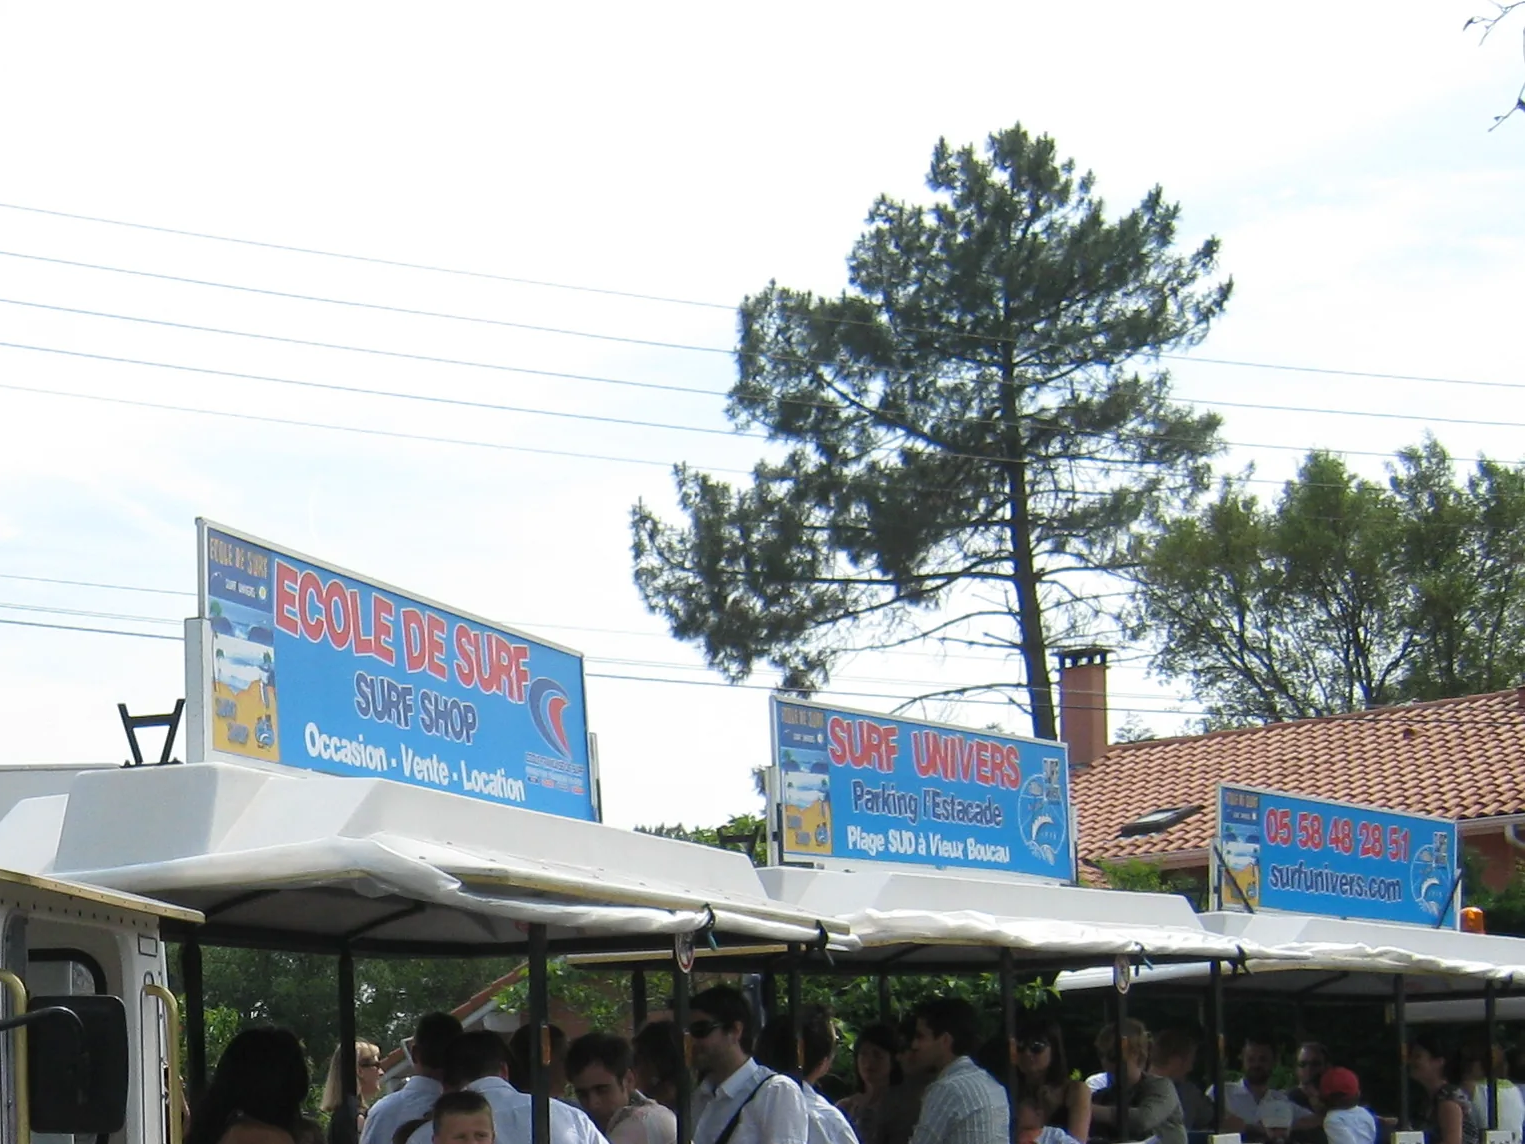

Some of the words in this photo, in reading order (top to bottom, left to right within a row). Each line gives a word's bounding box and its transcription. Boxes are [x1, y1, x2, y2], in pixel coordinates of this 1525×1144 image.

[275, 558, 395, 666] ECOLE
[401, 608, 448, 681] DE
[454, 622, 529, 704] SURF
[354, 671, 414, 730] SURF
[419, 689, 478, 745] SHOP
[304, 721, 388, 772] Occasion
[400, 743, 450, 787] Vente
[460, 767, 526, 802] Location
[828, 716, 899, 774] SURF
[911, 730, 1021, 790] UNIVERS
[851, 779, 919, 825] Parking
[922, 788, 1003, 828] l'Estacade
[1264, 807, 1293, 847] 05
[1296, 812, 1324, 851] 58
[1328, 817, 1354, 855] 48
[1358, 821, 1384, 858] 28
[1387, 826, 1410, 863] 51
[846, 825, 886, 858] Plage
[887, 829, 917, 855] SUD
[917, 833, 927, 855] à
[929, 832, 965, 860] Vieux
[967, 837, 1011, 863] Boucau
[1268, 859, 1403, 903] surfunivers.com
